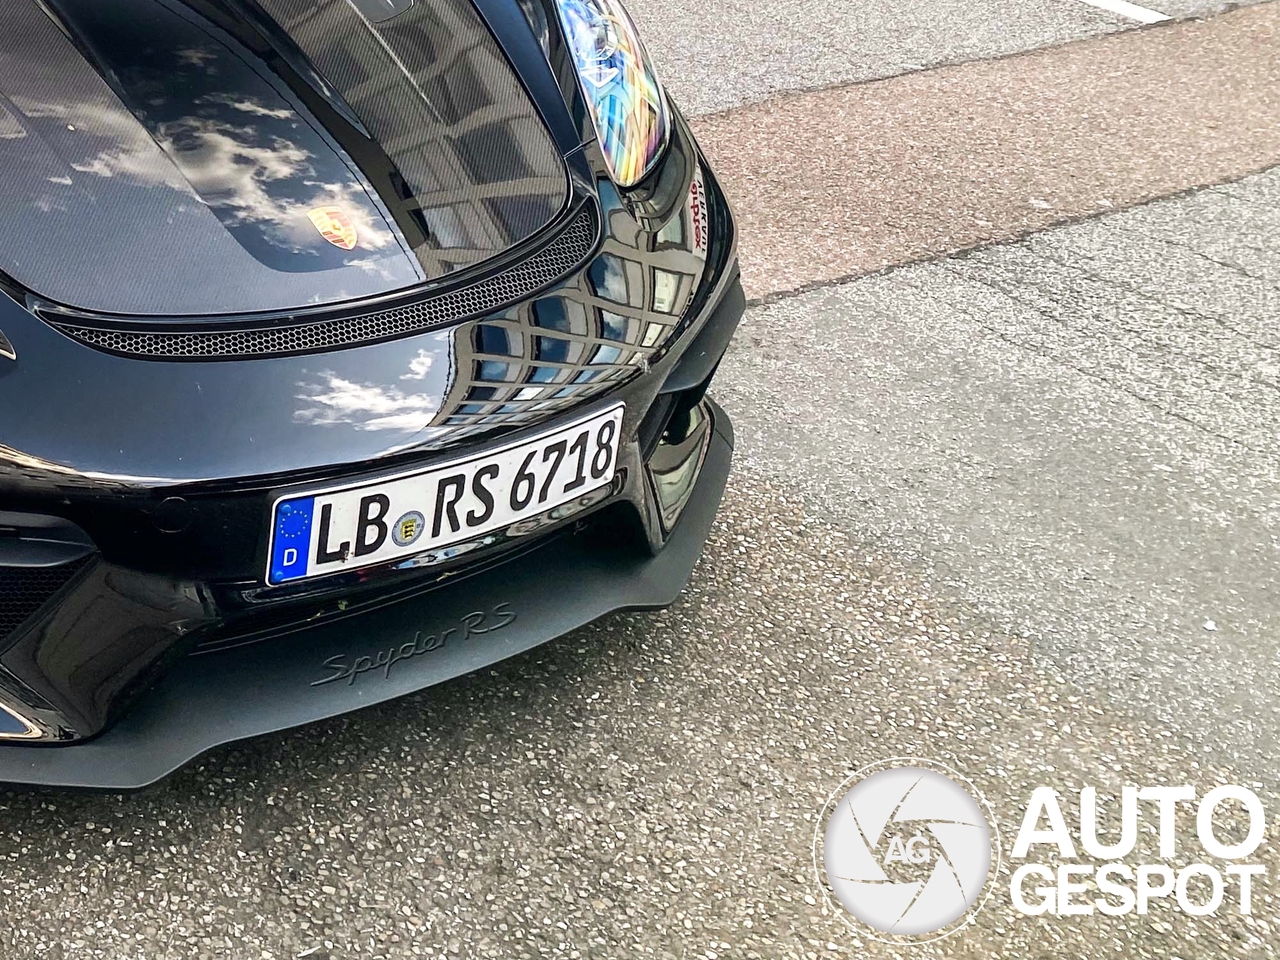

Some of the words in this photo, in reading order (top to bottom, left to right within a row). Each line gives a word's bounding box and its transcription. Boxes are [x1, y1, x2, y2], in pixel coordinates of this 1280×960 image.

[316, 493, 391, 566] LB
[431, 463, 500, 539] RS
[509, 419, 616, 512] 6718
[283, 548, 297, 567] D
[310, 628, 457, 687] Spyder
[460, 602, 517, 640] RS
